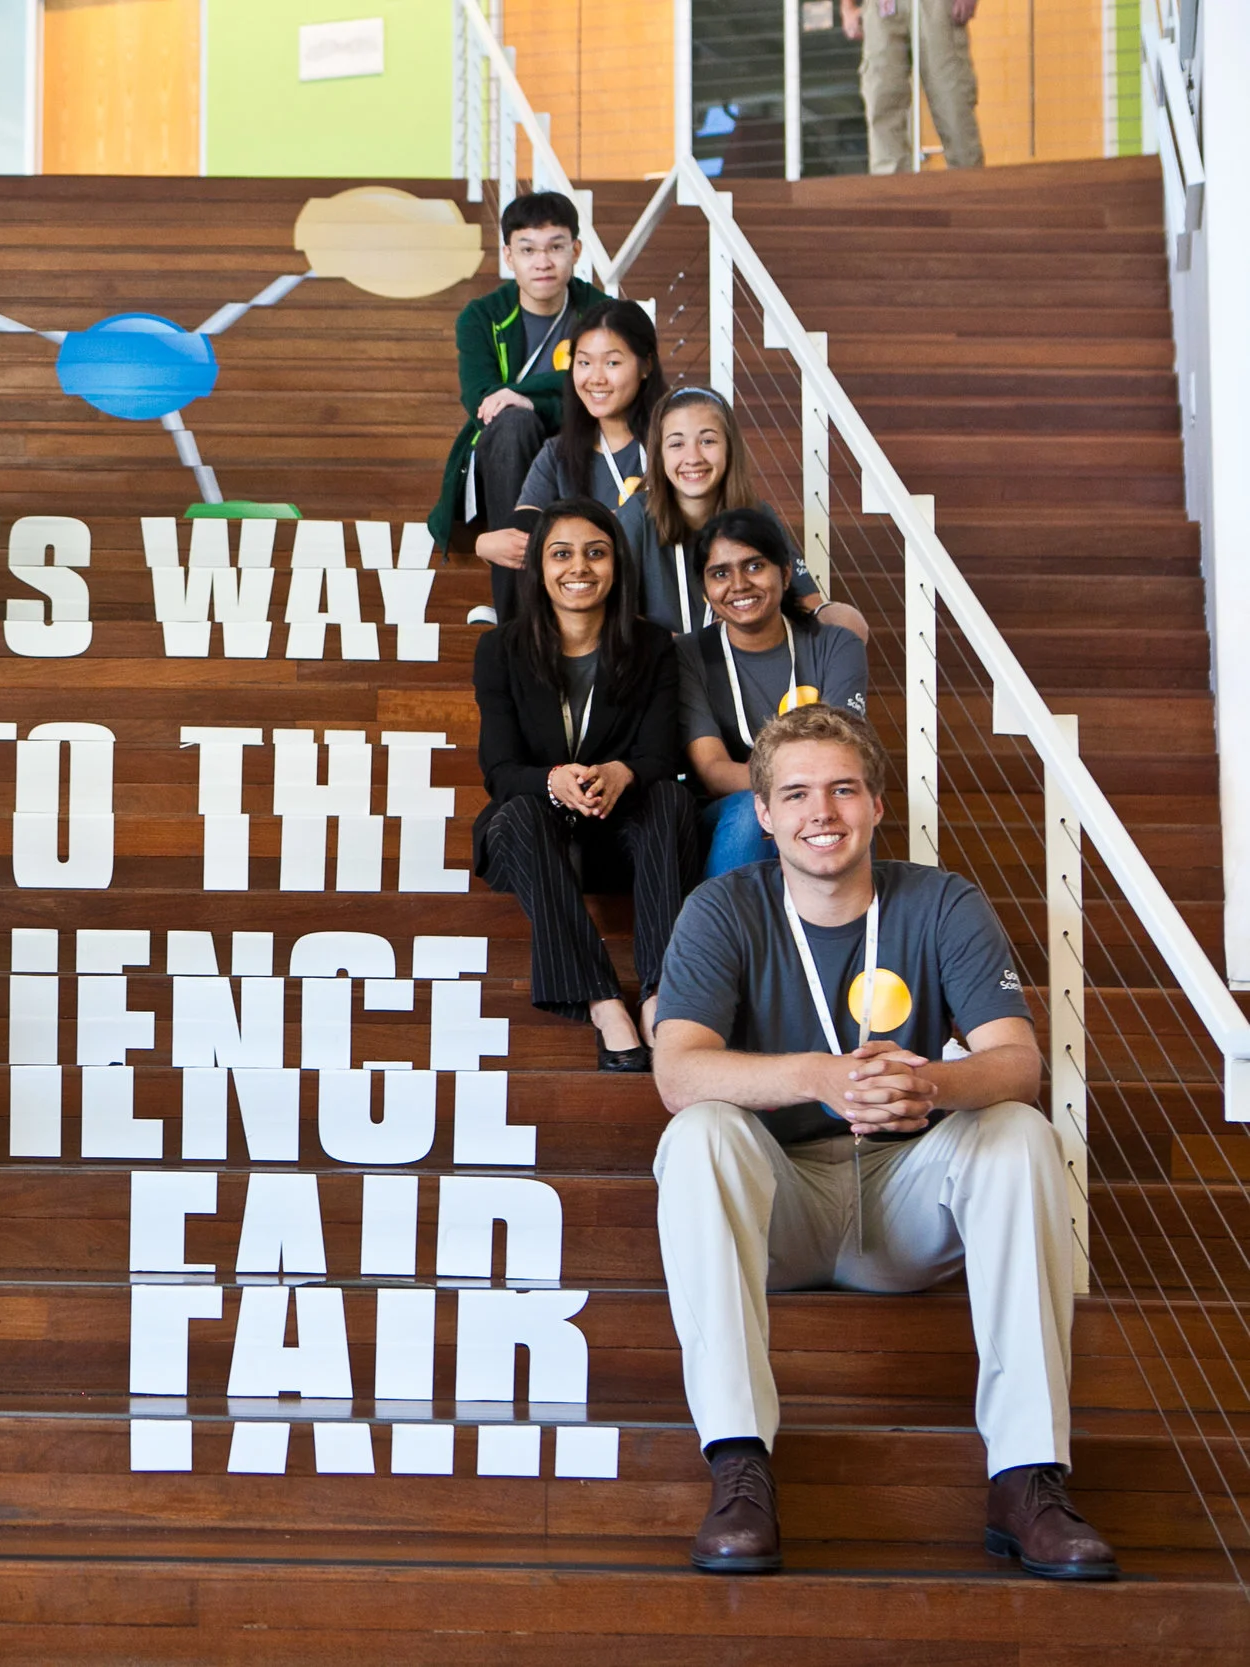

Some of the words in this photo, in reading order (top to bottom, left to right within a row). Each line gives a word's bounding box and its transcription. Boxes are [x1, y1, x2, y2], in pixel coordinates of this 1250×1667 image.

[140, 516, 441, 662] WAY
[179, 725, 470, 893] THE
[128, 1170, 619, 1479] FAIR
